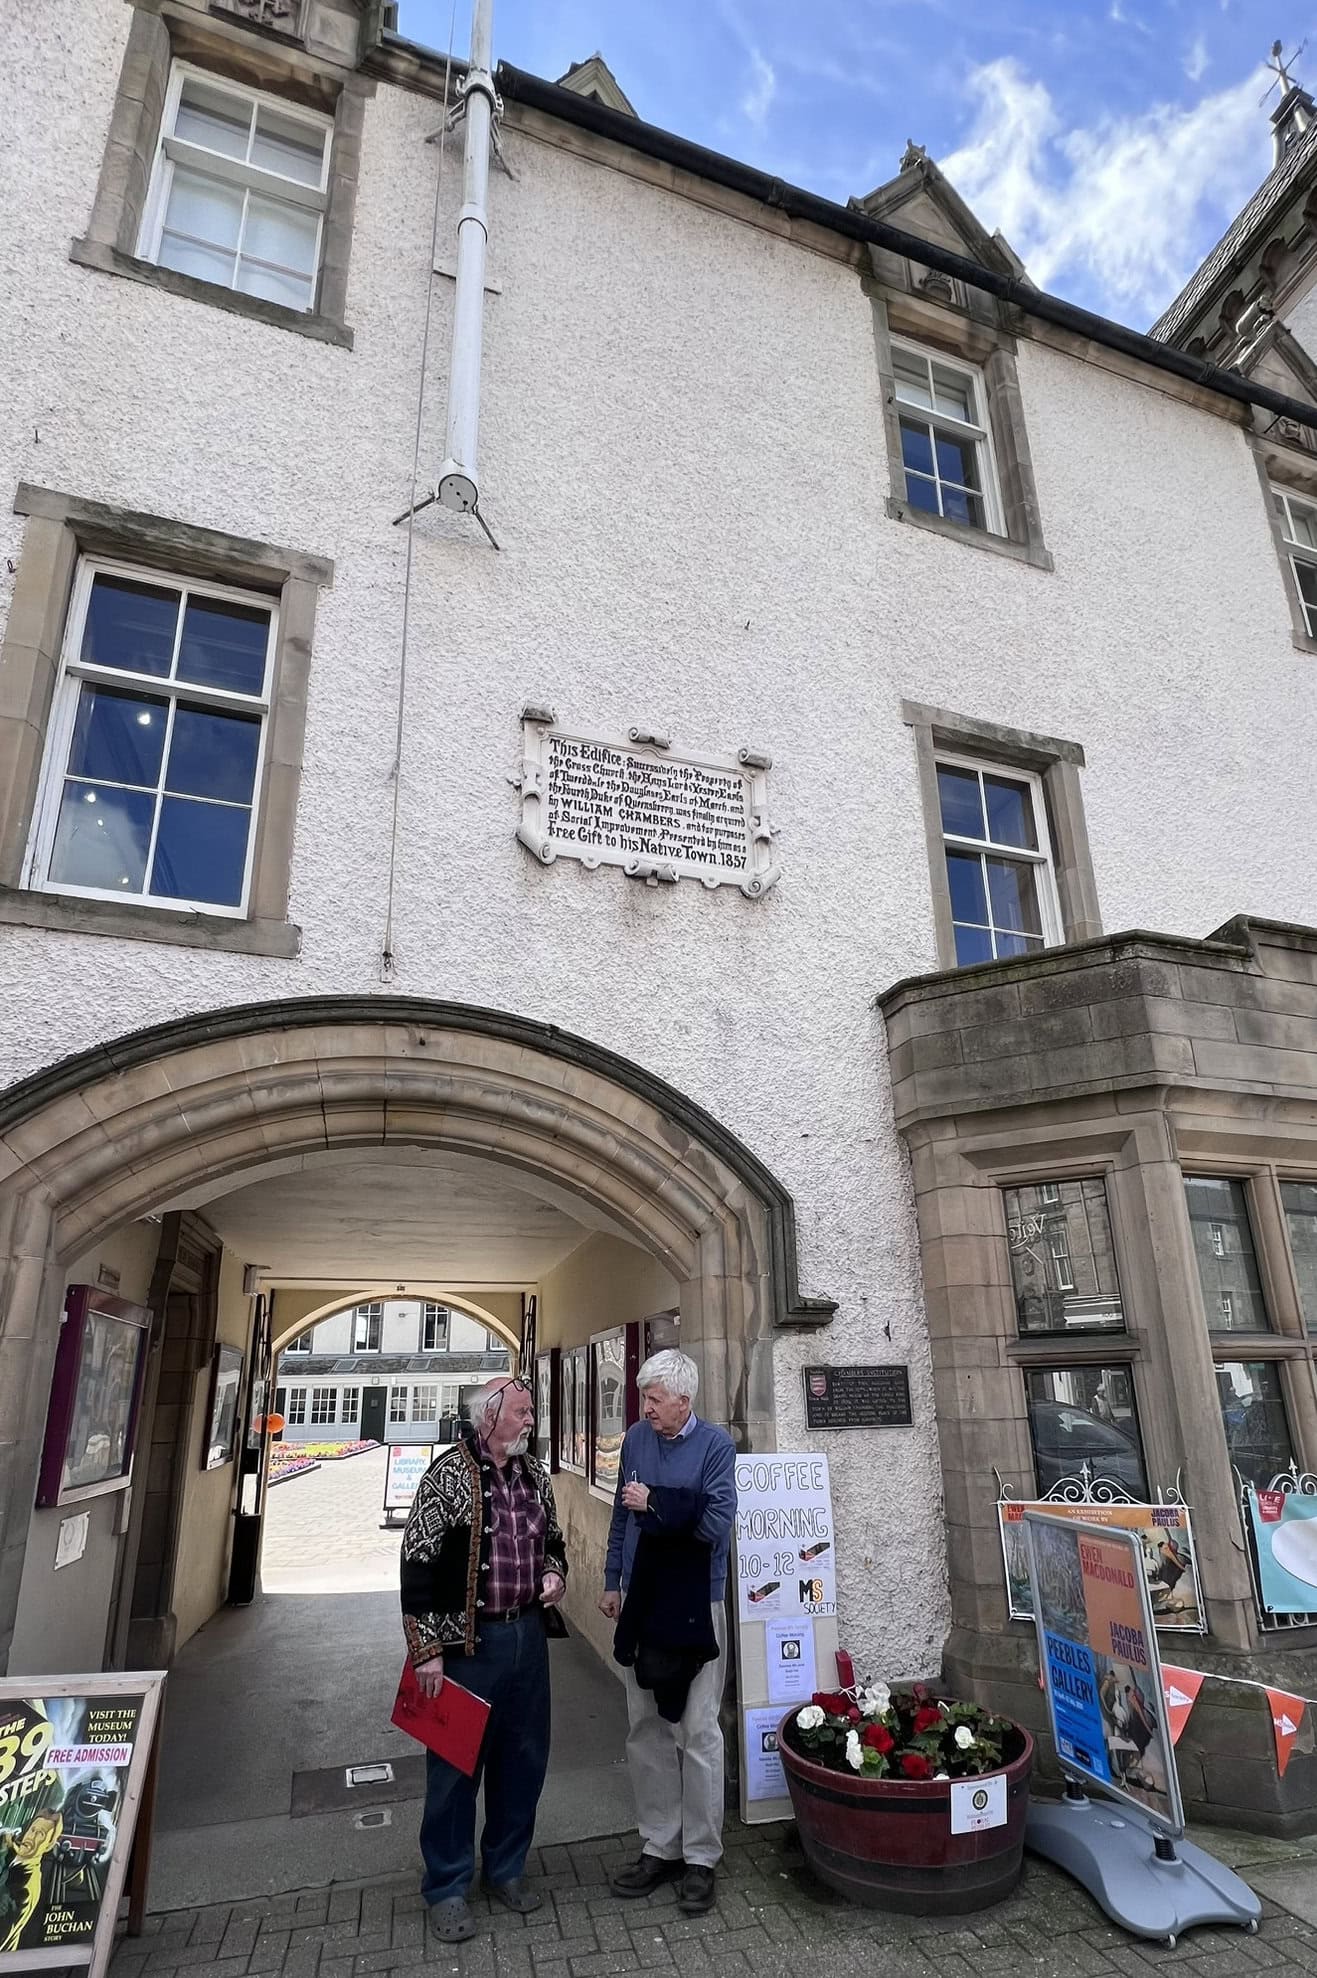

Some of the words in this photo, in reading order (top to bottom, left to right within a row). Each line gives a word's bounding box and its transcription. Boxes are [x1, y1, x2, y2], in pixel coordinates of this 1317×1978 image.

[548, 756, 564, 771] the
[564, 758, 592, 773] Cross
[628, 771, 642, 785] the
[549, 738, 579, 757] This
[679, 768, 693, 782] the
[692, 768, 732, 791] Property
[732, 780, 743, 790] of
[548, 782, 563, 796] the
[560, 783, 591, 802] Fourth
[587, 788, 613, 803] Duke
[613, 794, 624, 807] of
[675, 809, 691, 818] was
[691, 809, 715, 826] finally
[549, 769, 560, 782] of
[606, 780, 621, 793] the
[689, 796, 699, 807] of
[730, 805, 744, 815] and
[548, 795, 559, 810] by
[560, 798, 613, 817] WILLIAM
[686, 822, 701, 833] and
[701, 824, 714, 834] for
[547, 820, 576, 841] Free
[577, 827, 603, 845] Gift
[605, 835, 617, 847] to
[619, 835, 640, 853] his
[638, 837, 683, 858] Native
[720, 853, 747, 870] 1857
[548, 810, 560, 820] of
[560, 811, 593, 827] Social
[706, 837, 717, 851] by
[733, 845, 741, 853] as
[391, 1482, 419, 1490] GALLE
[735, 1461, 824, 1493] COFFEE
[736, 1507, 829, 1541] MORNING
[1151, 1508, 1180, 1518] JACOBA
[1152, 1518, 1181, 1528] PAULUS
[1082, 1560, 1136, 1589] MACDONALD
[799, 1578, 824, 1604] MS
[803, 1602, 837, 1615] SOCIETY
[1109, 1620, 1145, 1649] JACOBA
[1047, 1635, 1092, 1675] PEEBLES
[1111, 1638, 1147, 1667] PAULUS
[1051, 1664, 1095, 1706] GALLERY
[87, 1721, 133, 1732] MUSEUM
[89, 1710, 115, 1720] VISIT
[117, 1709, 137, 1719] THE
[88, 1733, 128, 1744] TODAY!
[47, 1748, 74, 1764] FREE
[74, 1747, 129, 1763] ADMISSION
[0, 1768, 58, 1808] STEPS
[43, 1910, 76, 1926] JOHN
[46, 1920, 94, 1935] BUCHAN
